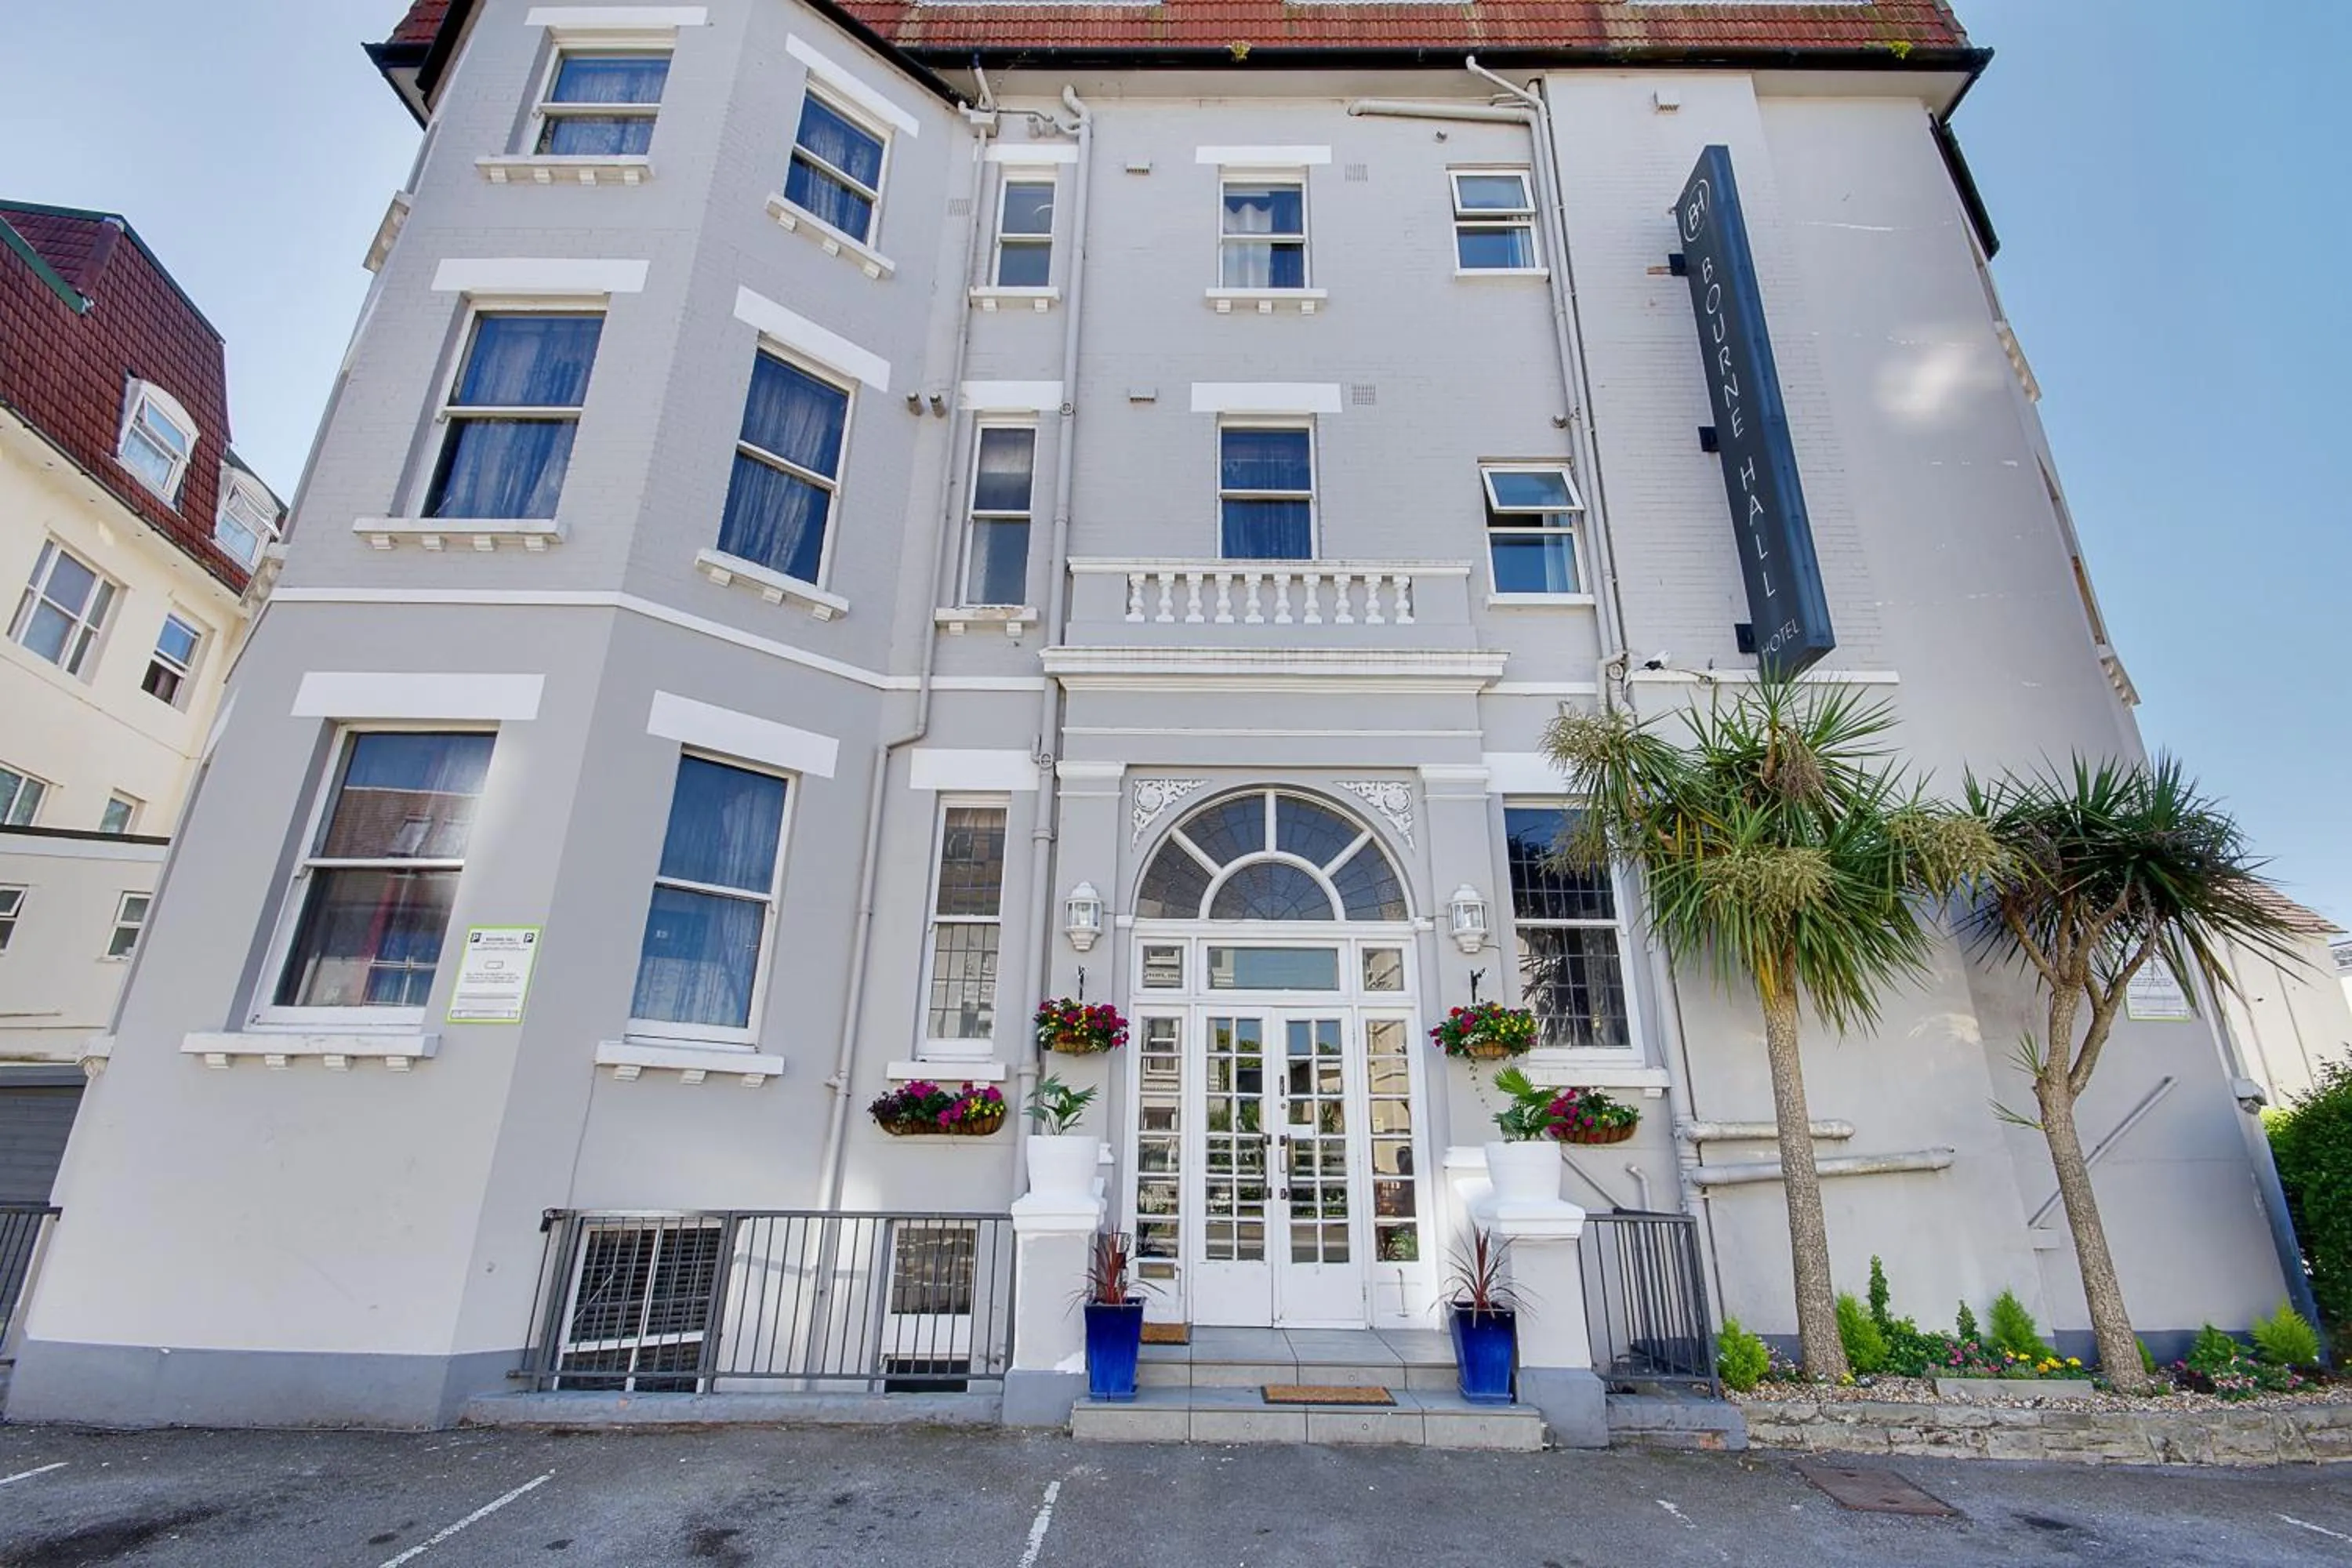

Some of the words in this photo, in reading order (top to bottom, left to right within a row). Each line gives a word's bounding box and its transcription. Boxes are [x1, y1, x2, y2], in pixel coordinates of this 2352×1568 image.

[1701, 256, 1744, 438] BOURNE
[1740, 456, 1776, 597] HALL
[1760, 618, 1799, 657] HOTEL
